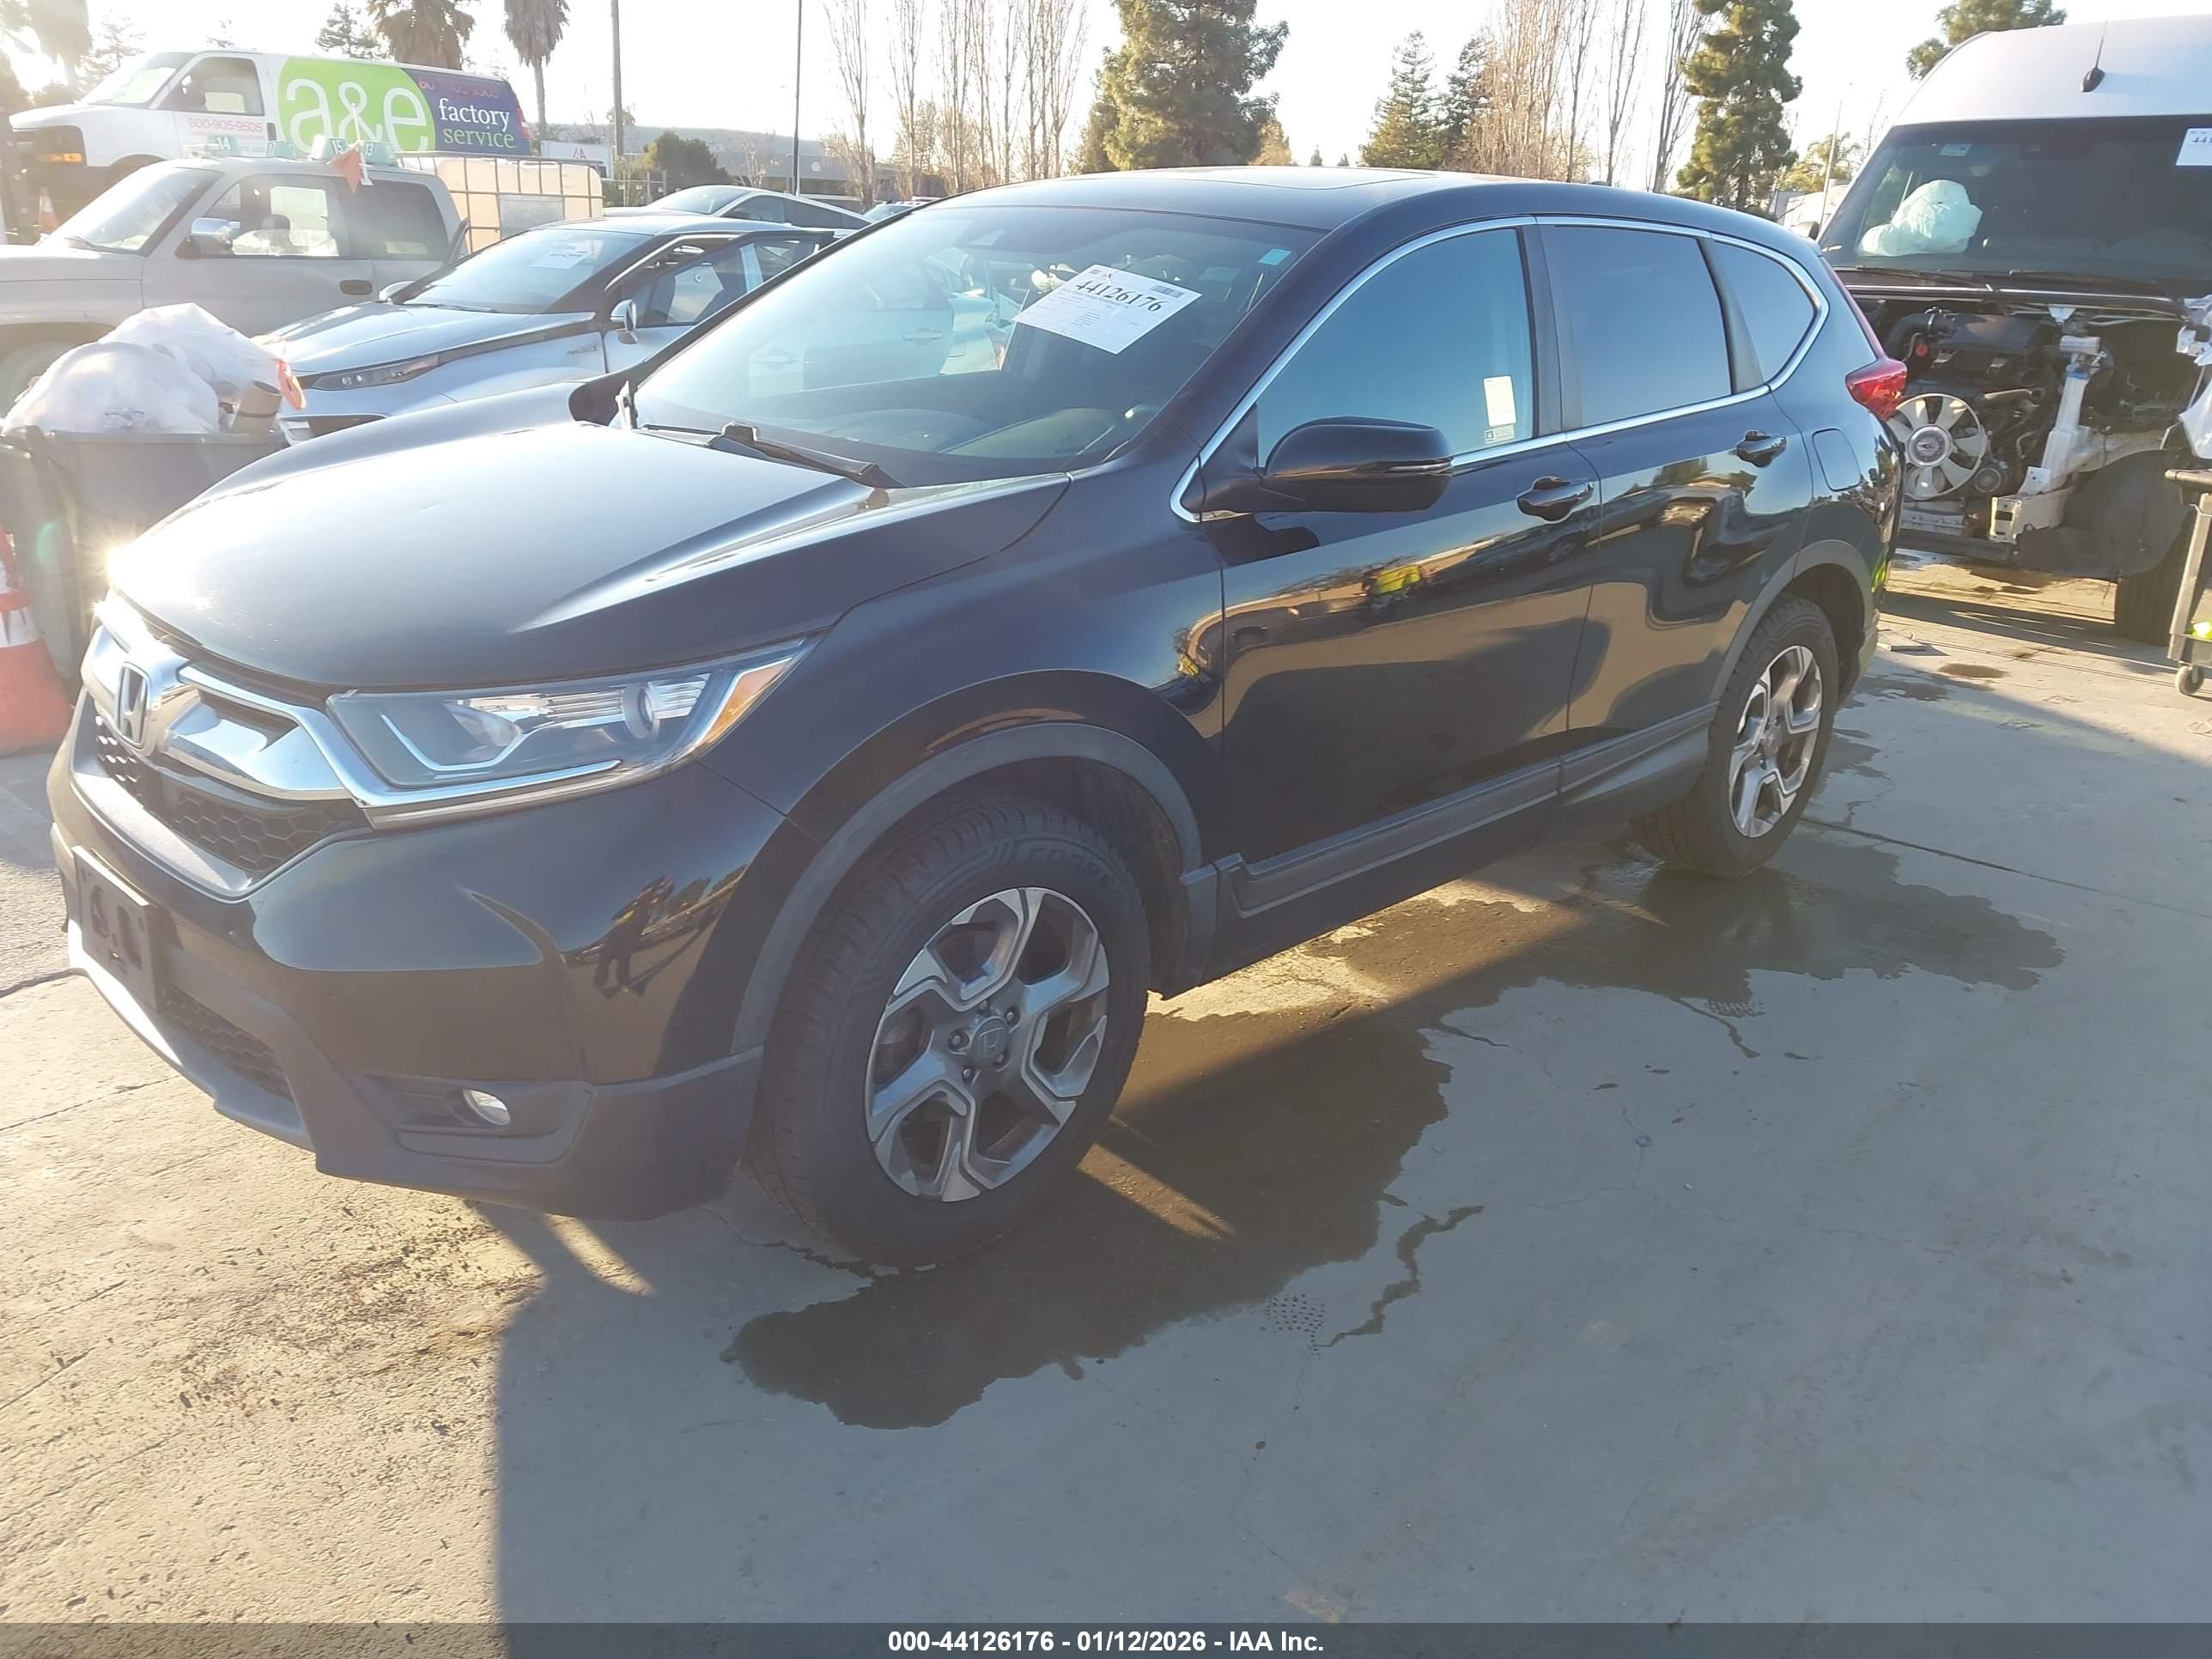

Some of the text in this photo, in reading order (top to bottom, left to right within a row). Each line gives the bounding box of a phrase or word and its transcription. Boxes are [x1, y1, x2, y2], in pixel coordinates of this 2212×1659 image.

[189, 118, 263, 132] 800-905-9505
[438, 97, 511, 132] factory
[442, 126, 515, 149] service
[1075, 280, 1170, 312] 44126176
